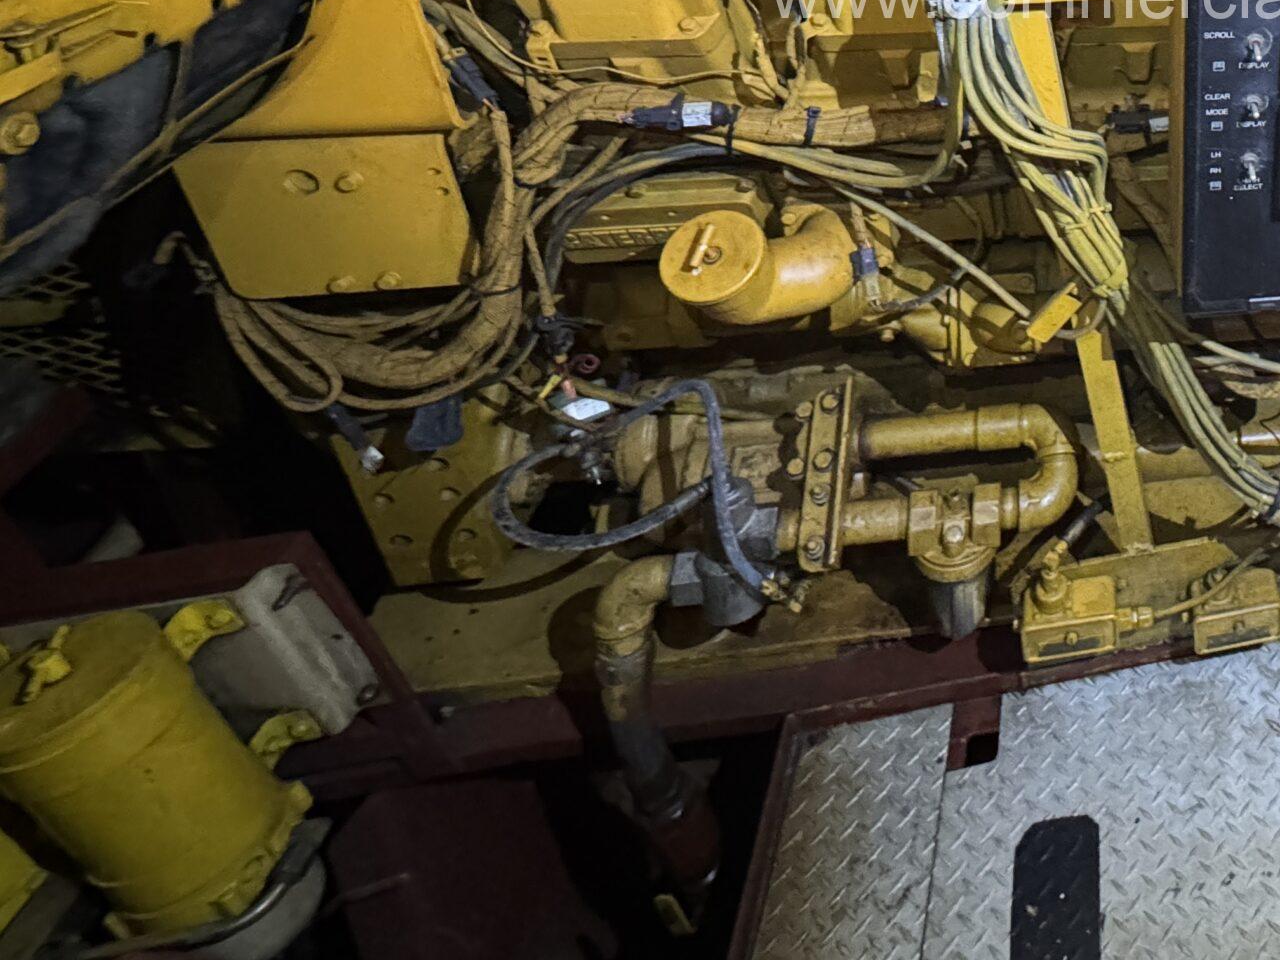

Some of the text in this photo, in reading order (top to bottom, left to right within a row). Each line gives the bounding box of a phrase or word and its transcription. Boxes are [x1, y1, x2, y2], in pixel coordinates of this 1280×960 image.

[1204, 31, 1235, 39] SCROLL
[1204, 93, 1231, 101] CLEAR
[1205, 108, 1229, 116] MODE
